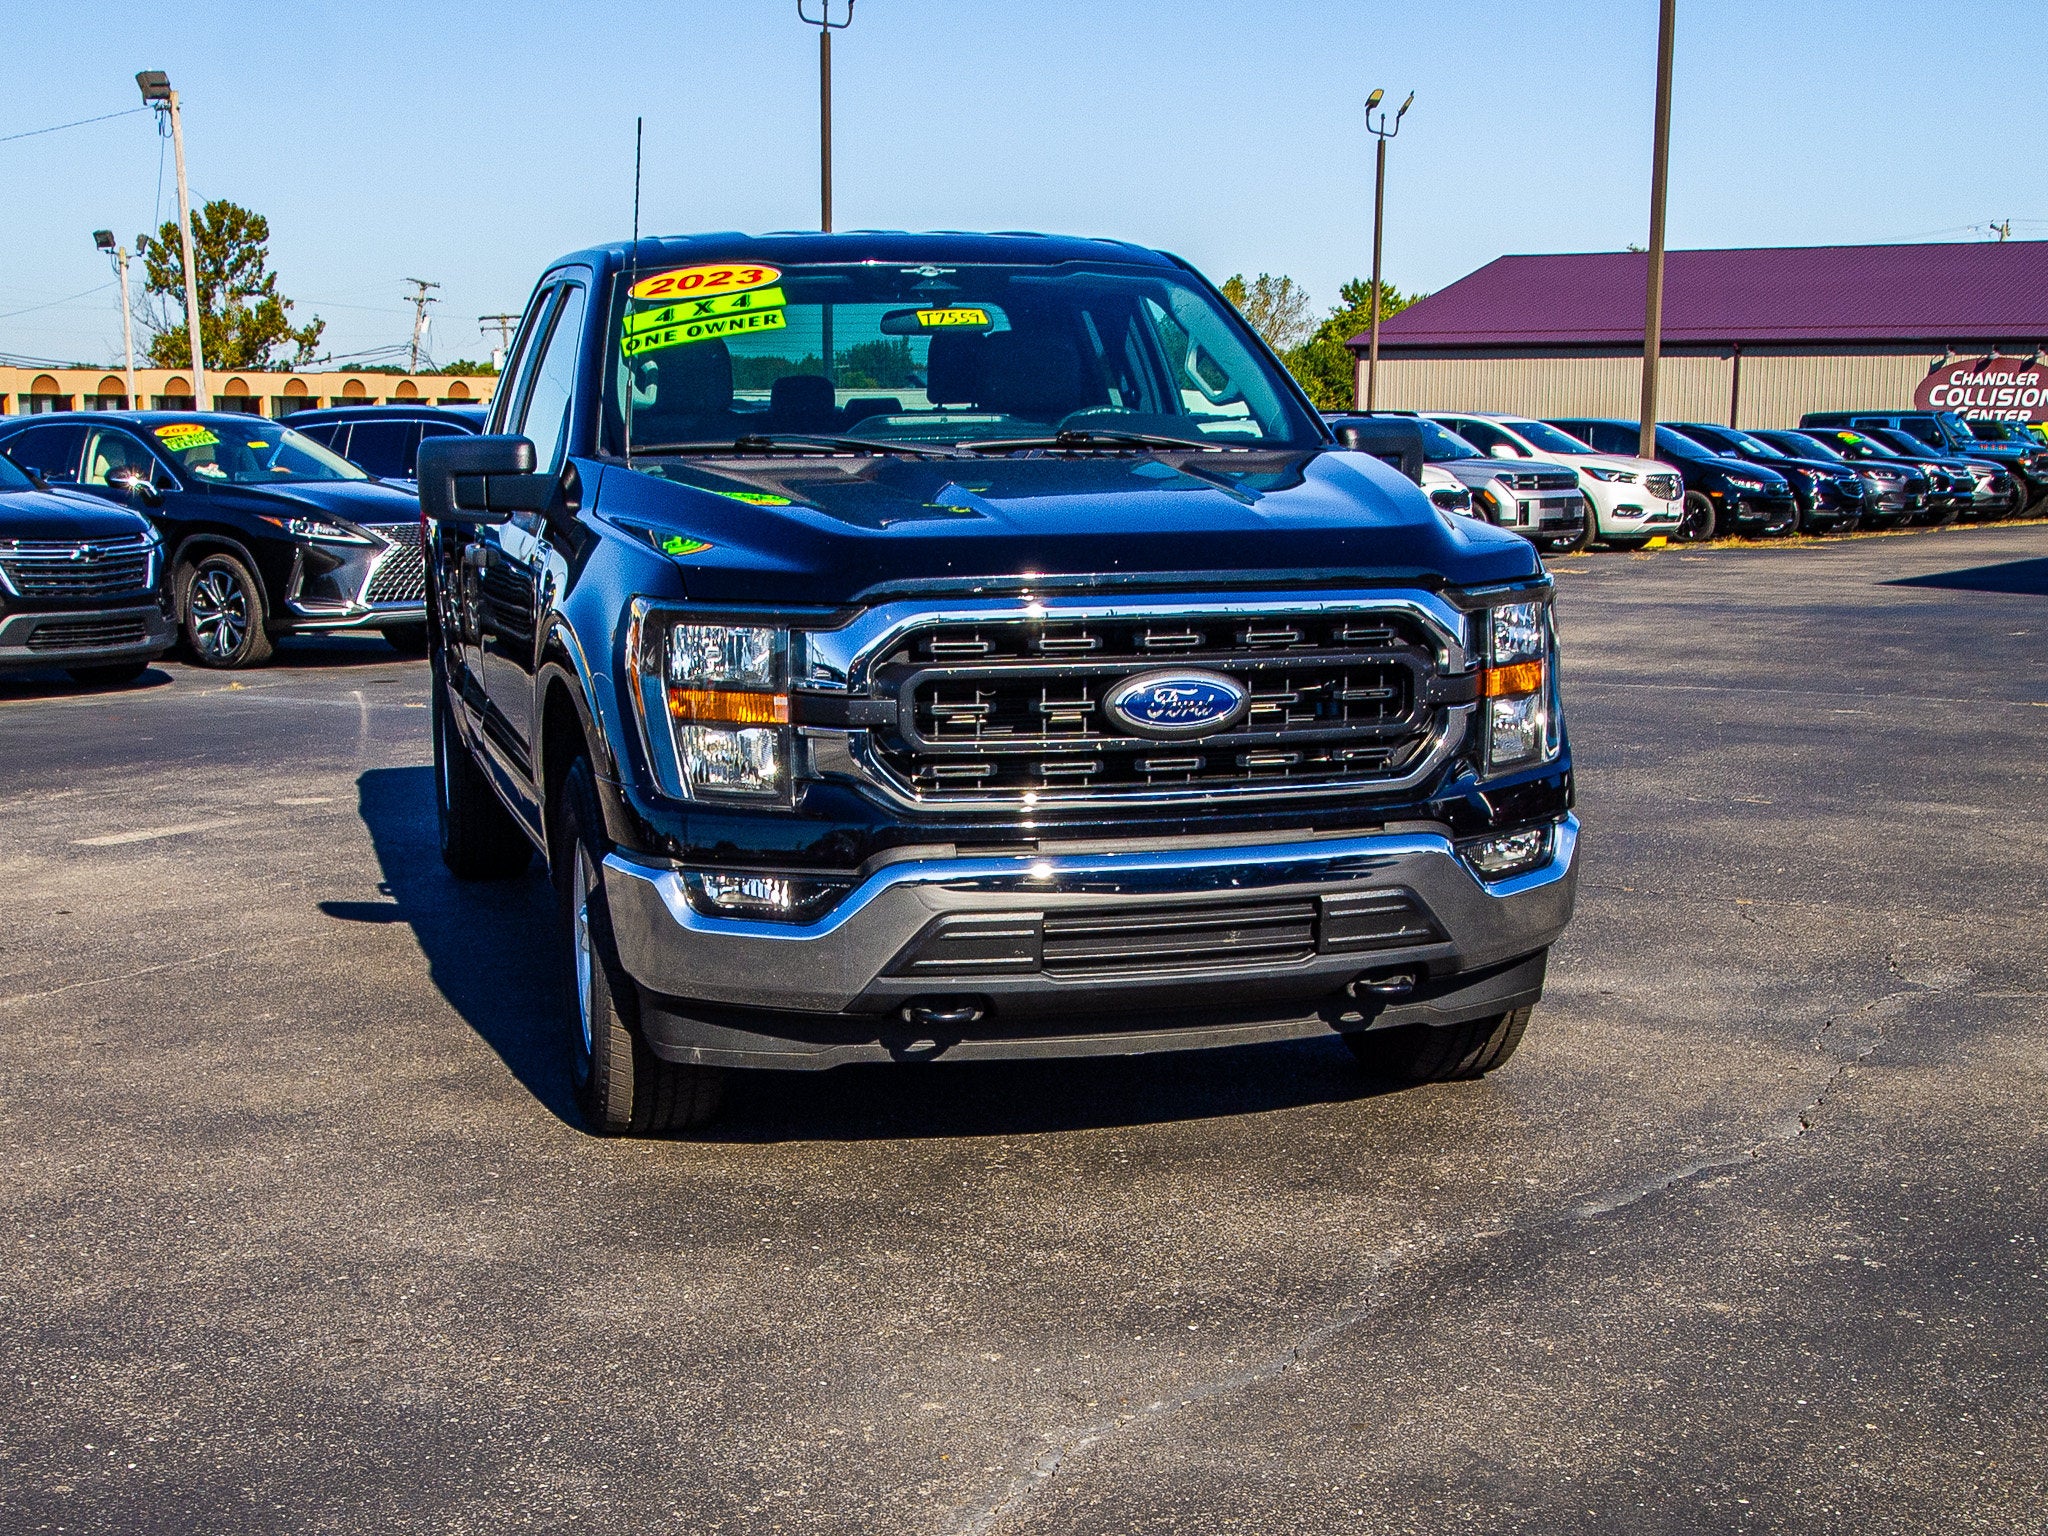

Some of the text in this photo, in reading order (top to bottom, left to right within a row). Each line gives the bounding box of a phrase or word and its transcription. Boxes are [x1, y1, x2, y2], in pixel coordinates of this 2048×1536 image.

[645, 269, 764, 296] 2023
[654, 307, 675, 322] 4
[731, 294, 751, 308] 4
[625, 313, 779, 351] ONE OWNER
[1950, 369, 2040, 386] CHANDLER
[1147, 688, 1215, 718] Ford
